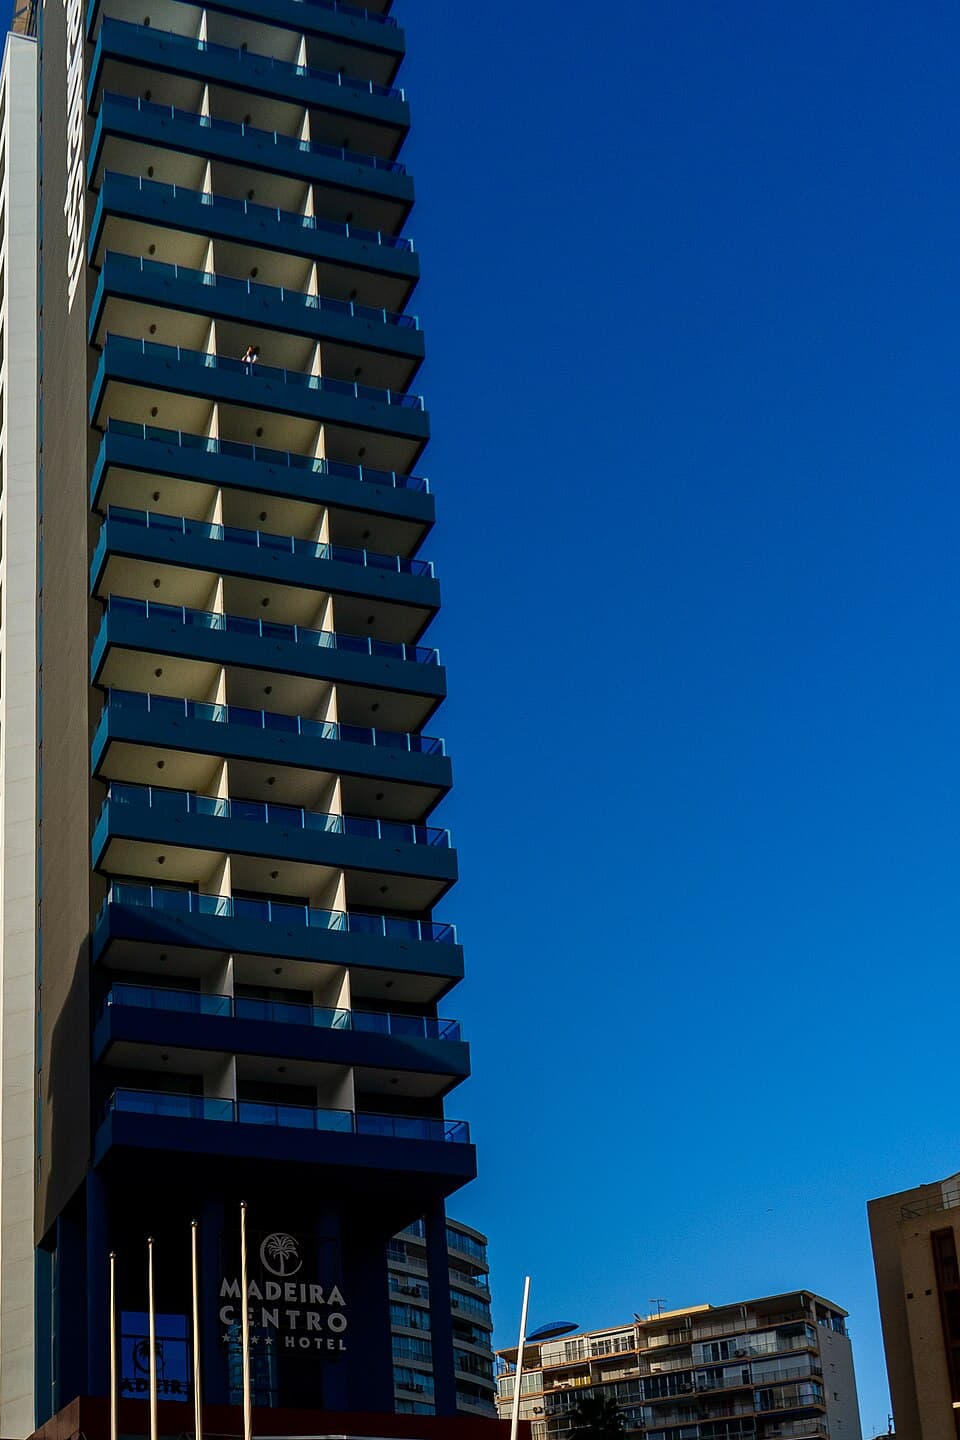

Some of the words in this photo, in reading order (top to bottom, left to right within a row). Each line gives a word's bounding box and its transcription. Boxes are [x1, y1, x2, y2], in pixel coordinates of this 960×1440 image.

[219, 1277, 347, 1306] MADEIRA
[219, 1305, 348, 1333] CENTRO
[284, 1336, 347, 1351] HOTEL
